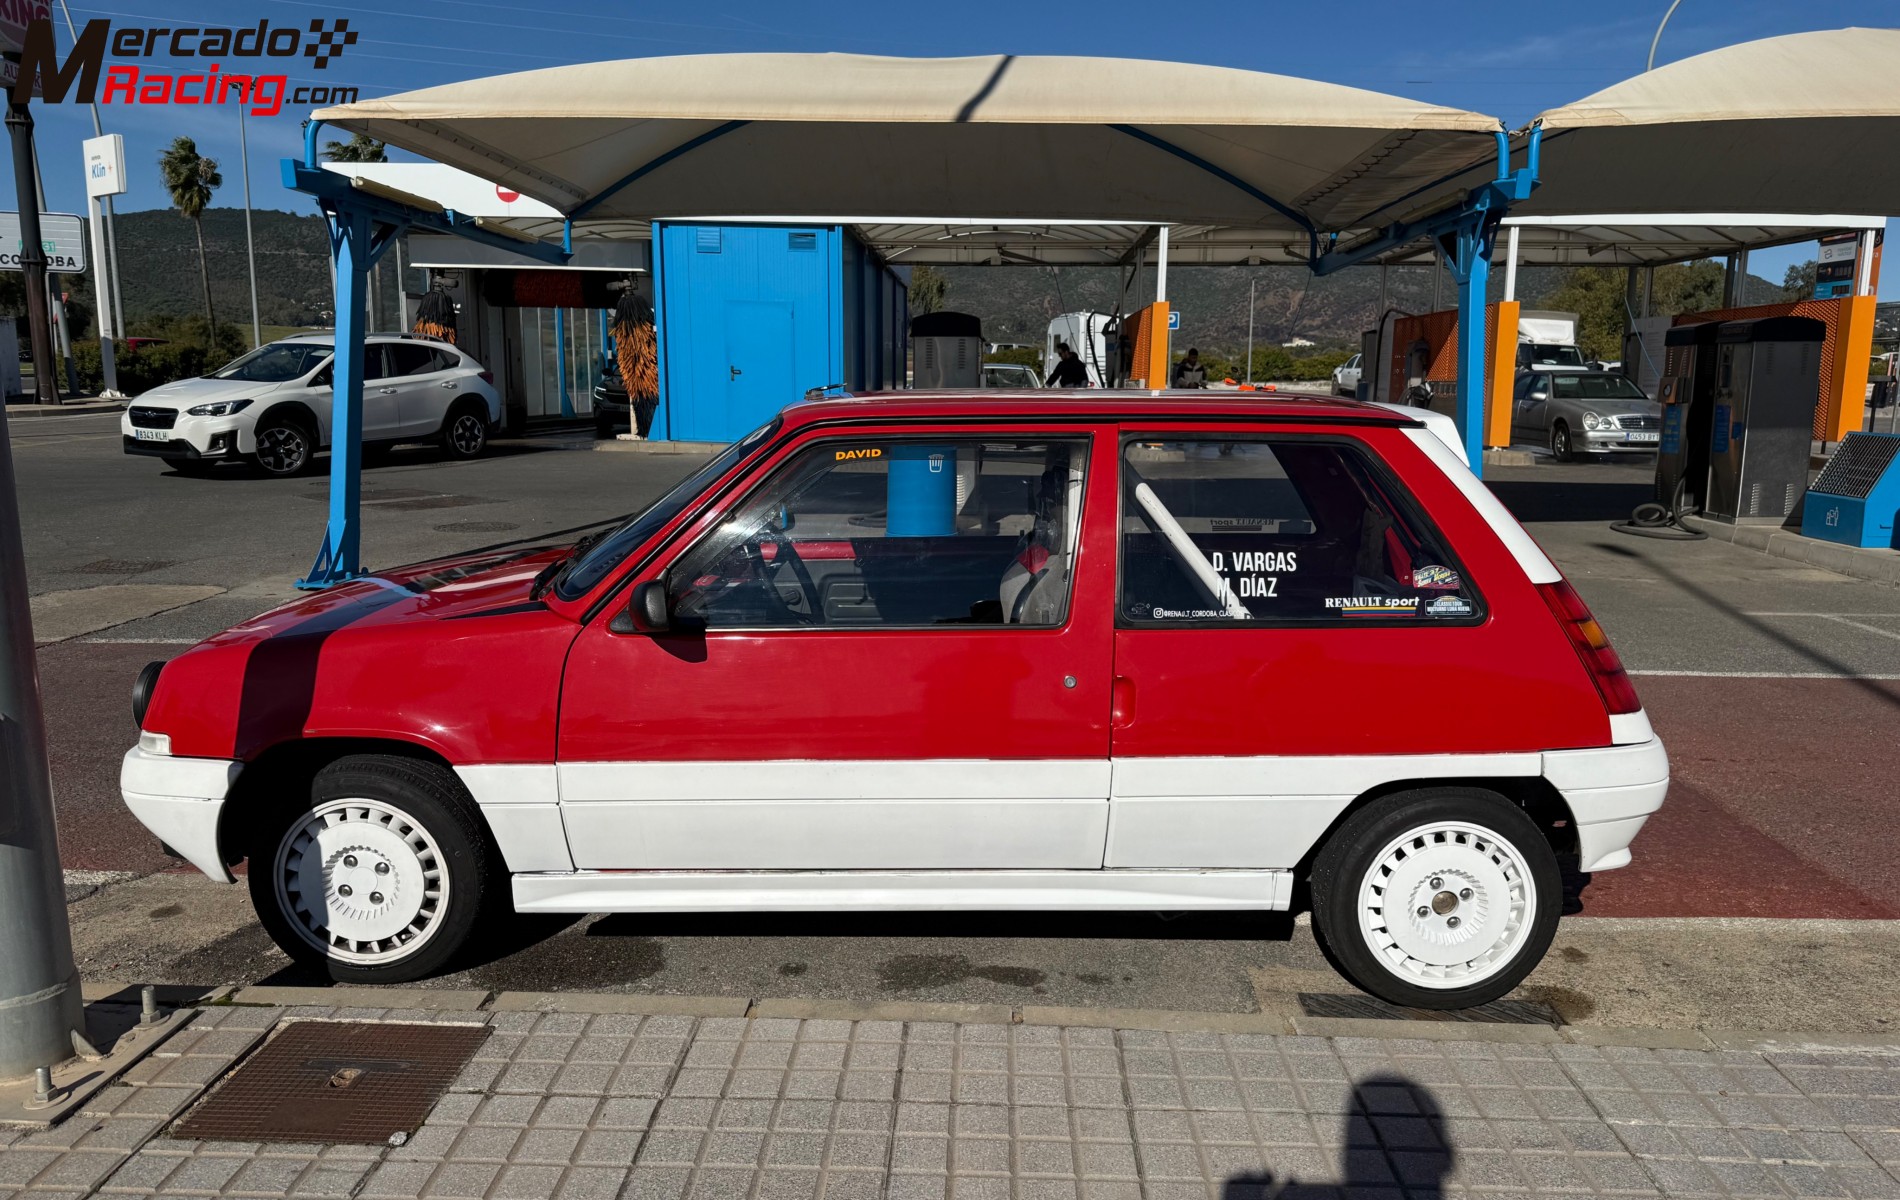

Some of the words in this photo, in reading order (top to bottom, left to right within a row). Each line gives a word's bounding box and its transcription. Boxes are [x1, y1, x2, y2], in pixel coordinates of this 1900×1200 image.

[0, 254, 77, 268] COOBA
[835, 449, 882, 461] DAVID
[1213, 552, 1228, 572] D.
[1232, 552, 1297, 572] VARGAS
[1217, 577, 1235, 597] M.
[1240, 573, 1278, 597] DÍAZ
[1325, 597, 1382, 608] RENAULT
[1384, 596, 1420, 609] sport
